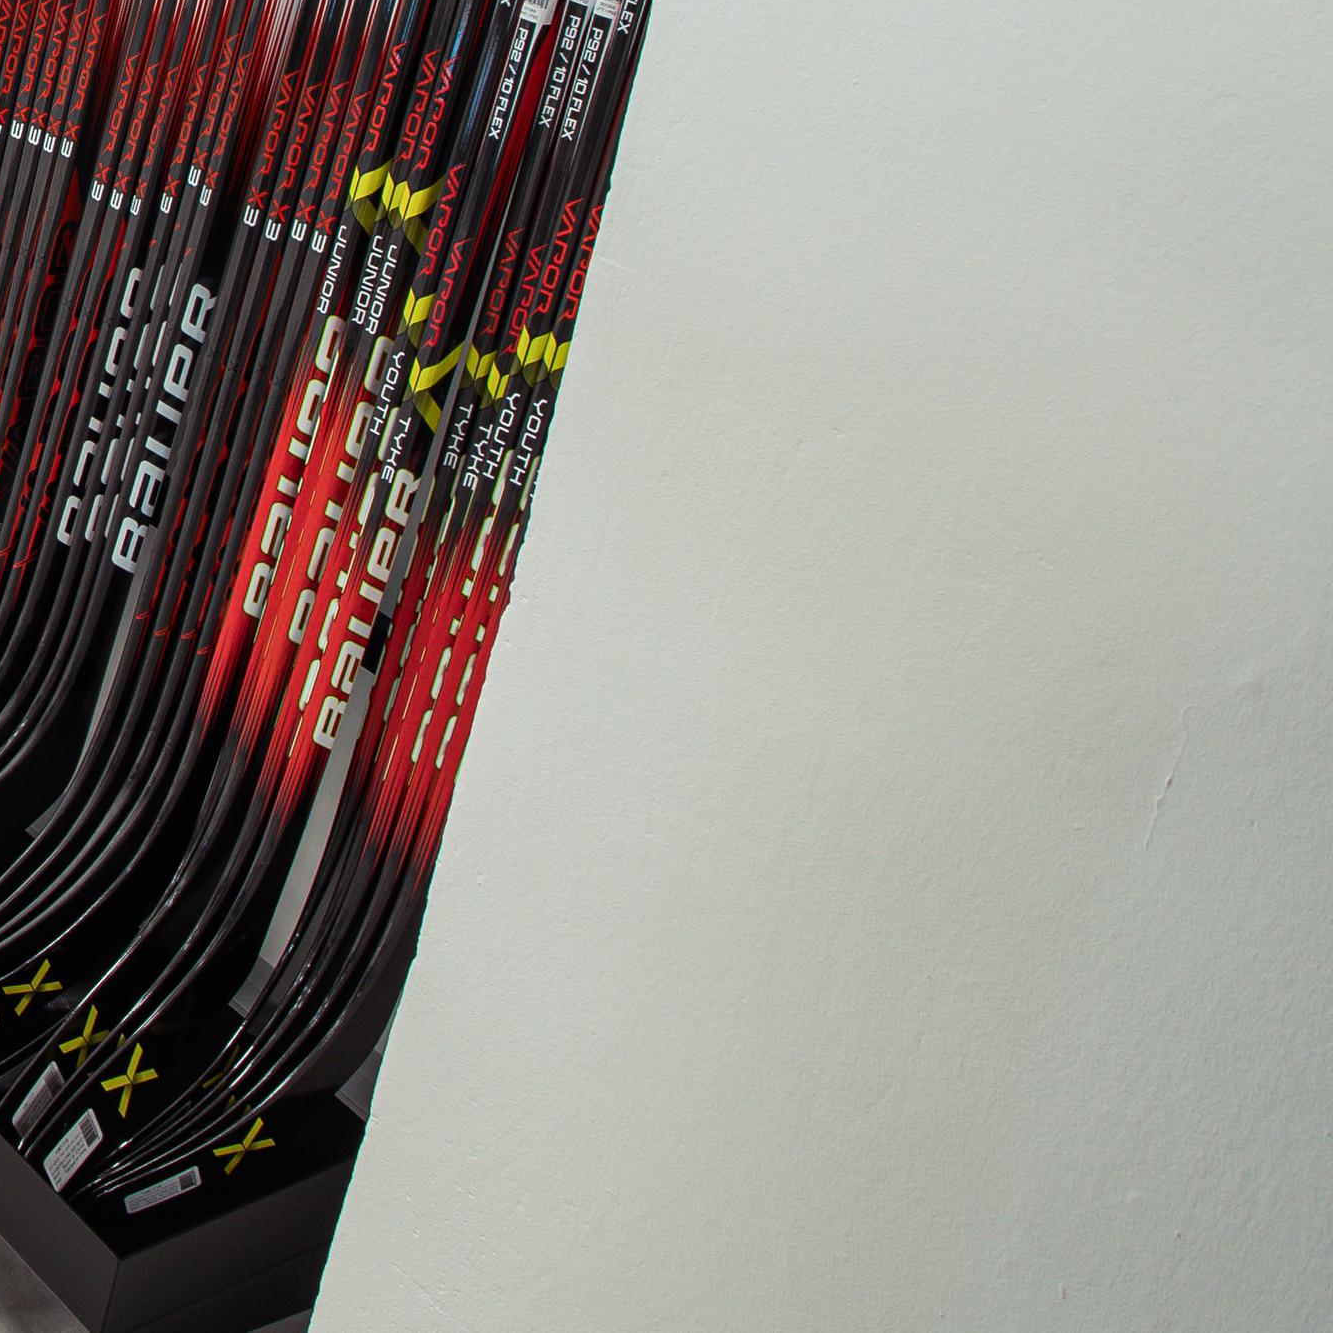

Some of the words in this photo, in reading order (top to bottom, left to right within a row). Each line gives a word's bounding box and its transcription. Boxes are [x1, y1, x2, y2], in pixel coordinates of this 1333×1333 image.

[69, 14, 107, 116] VAPOR
[511, 26, 528, 63] P92
[553, 66, 566, 84] 10
[562, 15, 580, 51] P92
[585, 26, 604, 63] P92
[102, 53, 141, 154] VAPOR
[254, 70, 300, 179] VAPOR
[361, 42, 406, 155] VAPOR
[393, 49, 441, 163] VAPOR
[412, 57, 458, 173] VAPOR
[488, 96, 509, 140] FLEX
[501, 76, 515, 95] 10
[539, 85, 560, 129] FLEX
[561, 97, 582, 141] FLEX
[574, 77, 588, 96] 10
[275, 82, 325, 193] VAPOR
[302, 81, 349, 192] VAPOR
[323, 91, 371, 203] VAPOR
[417, 164, 466, 278] VAPOR
[531, 198, 584, 317] VAPOR
[317, 225, 347, 315] JUNIOR
[352, 235, 382, 325] JUNIOR
[365, 244, 397, 335] JUNIOR
[424, 238, 471, 349] VAPOR
[481, 227, 525, 335] VAPOR
[501, 244, 548, 356] VAPOR
[111, 282, 219, 574] BAUER
[370, 351, 405, 436] YOUTH
[443, 403, 473, 469] TYKE
[483, 393, 521, 480] YOUTH
[382, 417, 412, 484] TYKE
[463, 424, 493, 491] TYKE
[510, 398, 548, 486] YOUTH
[313, 468, 421, 750] BAUER
